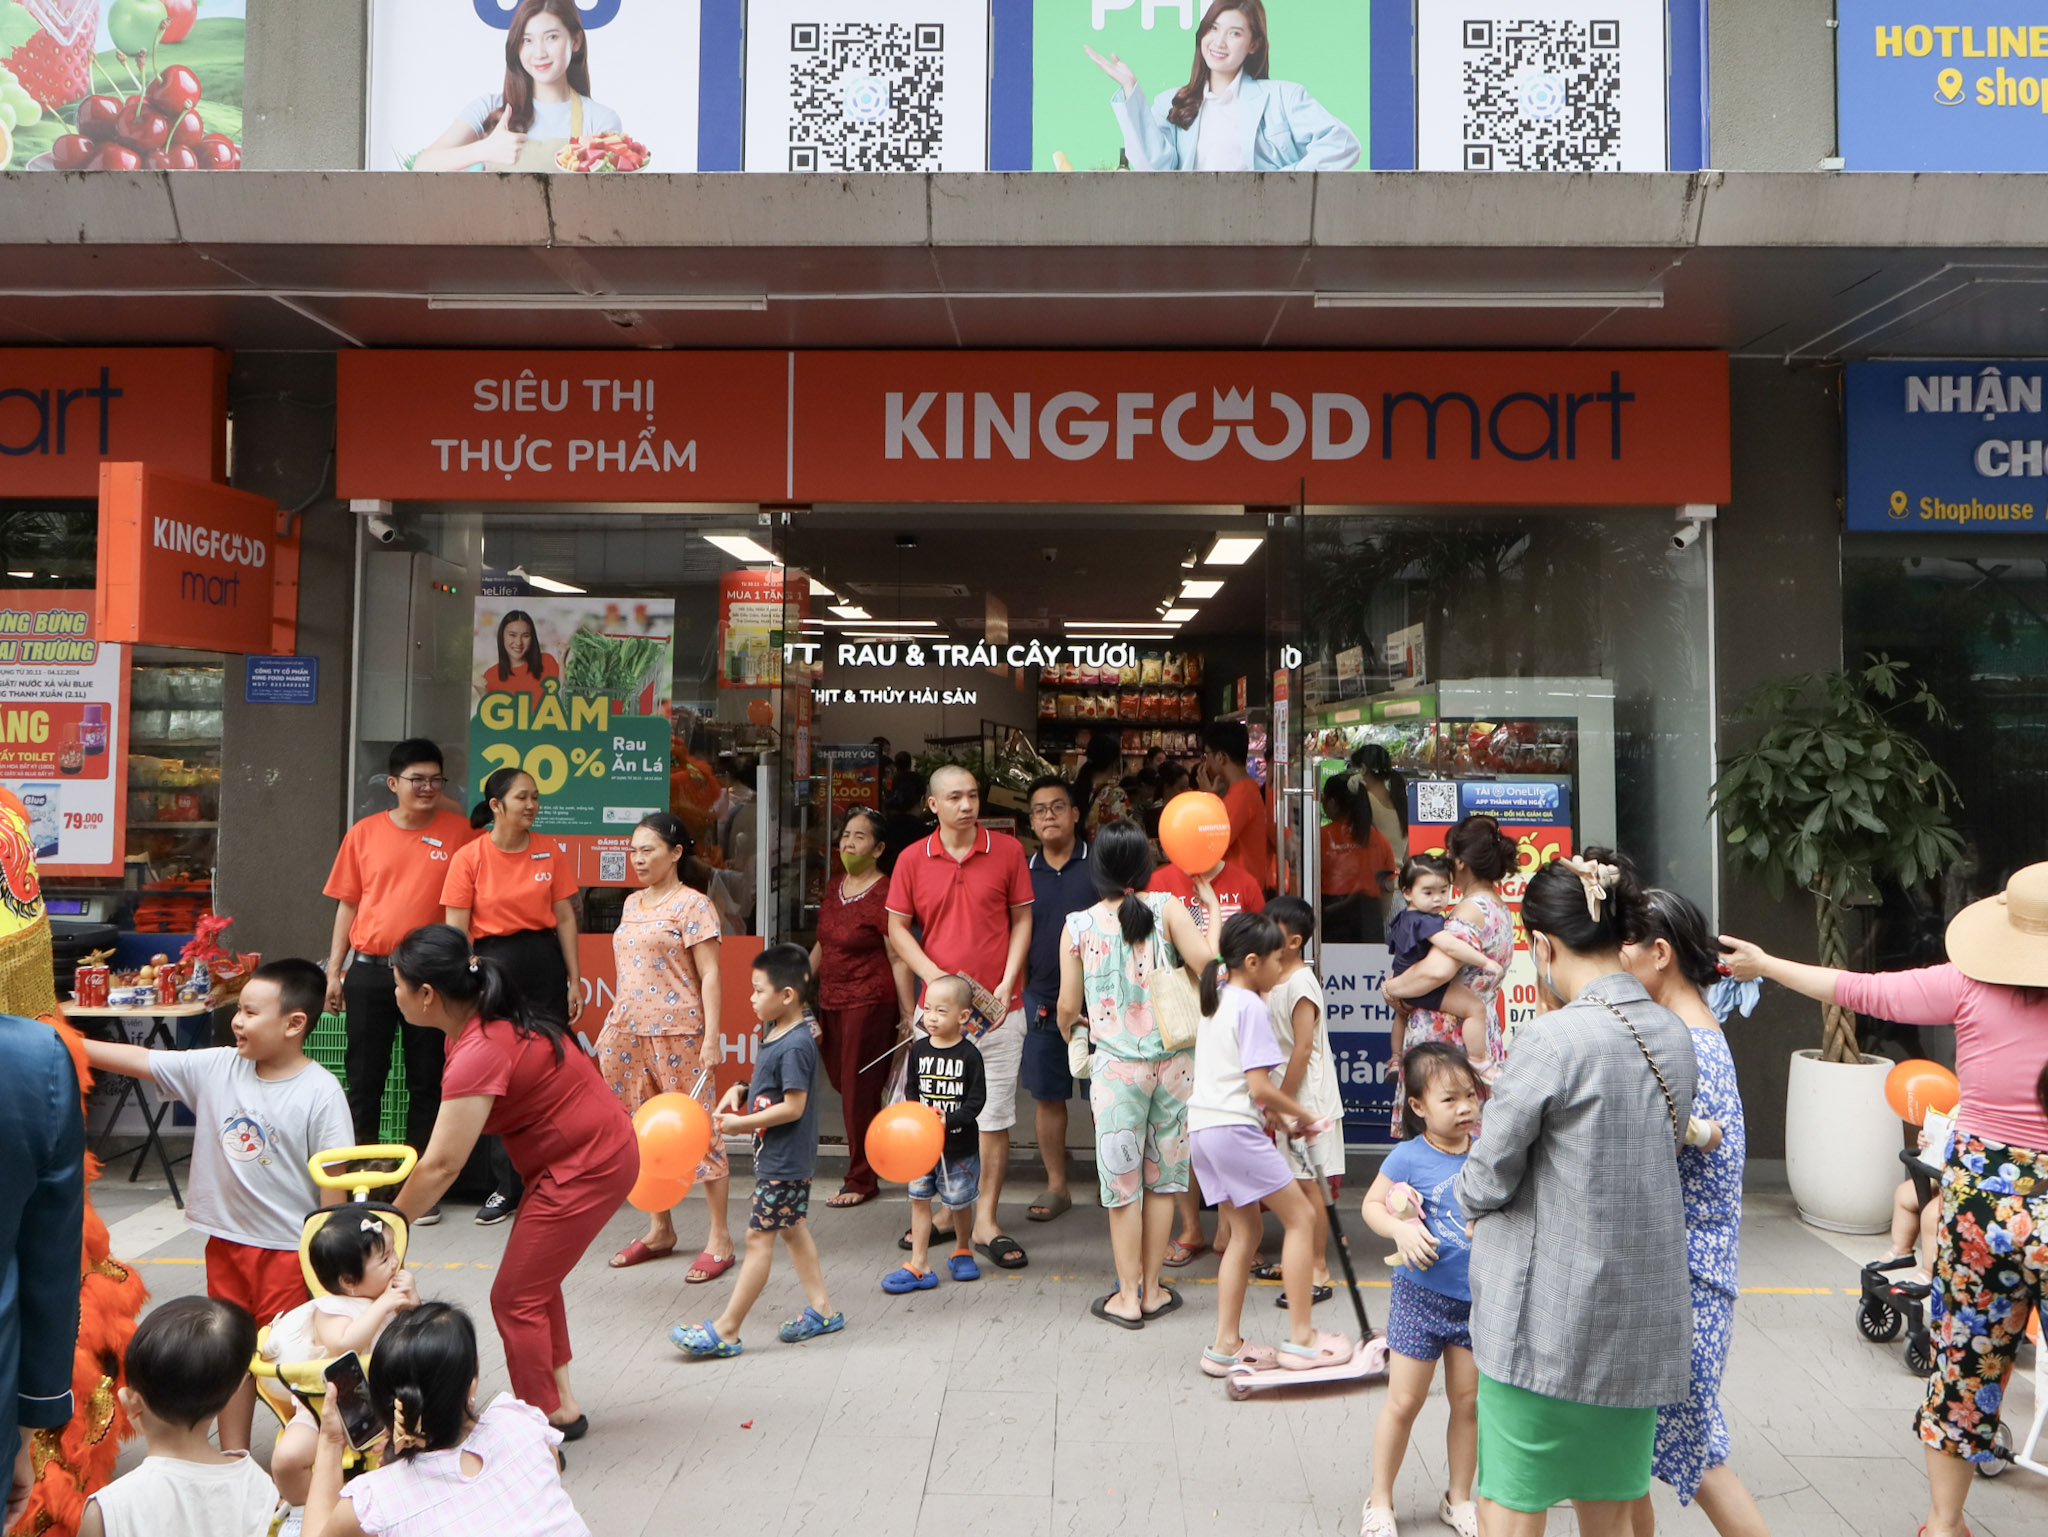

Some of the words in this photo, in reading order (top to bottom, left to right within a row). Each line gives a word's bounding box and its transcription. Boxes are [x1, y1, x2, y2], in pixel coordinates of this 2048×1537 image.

[1875, 25, 2048, 57] HOTLINE
[473, 369, 569, 412] SIÊU
[582, 379, 654, 421] THỊ
[1906, 367, 2042, 421] NHẬN
[431, 434, 552, 481] THỰC
[568, 426, 696, 472] PHẨM
[1920, 497, 2034, 524] Shophouse
[154, 516, 266, 567] KINGFOOD
[182, 571, 240, 608] mart
[726, 590, 751, 599] MUA
[755, 591, 760, 599] 1
[838, 644, 897, 666] RAU
[905, 644, 925, 666] &
[932, 638, 997, 666] TRÁI
[1007, 638, 1061, 667] CÂY
[1067, 642, 1135, 667] TƯƠI
[480, 680, 609, 732] GIẢM
[844, 689, 856, 703] &
[860, 686, 905, 703] THỦY
[909, 687, 938, 704] HẢI
[942, 687, 977, 704] SẢN
[17, 752, 55, 761] TOILET
[613, 737, 646, 751] Rau
[612, 754, 636, 772] Ăn
[642, 756, 663, 772] Lá
[1507, 787, 1546, 796] OneLife
[918, 1056, 934, 1075] MY
[936, 1058, 964, 1077] DAD
[936, 1080, 964, 1095] MAN
